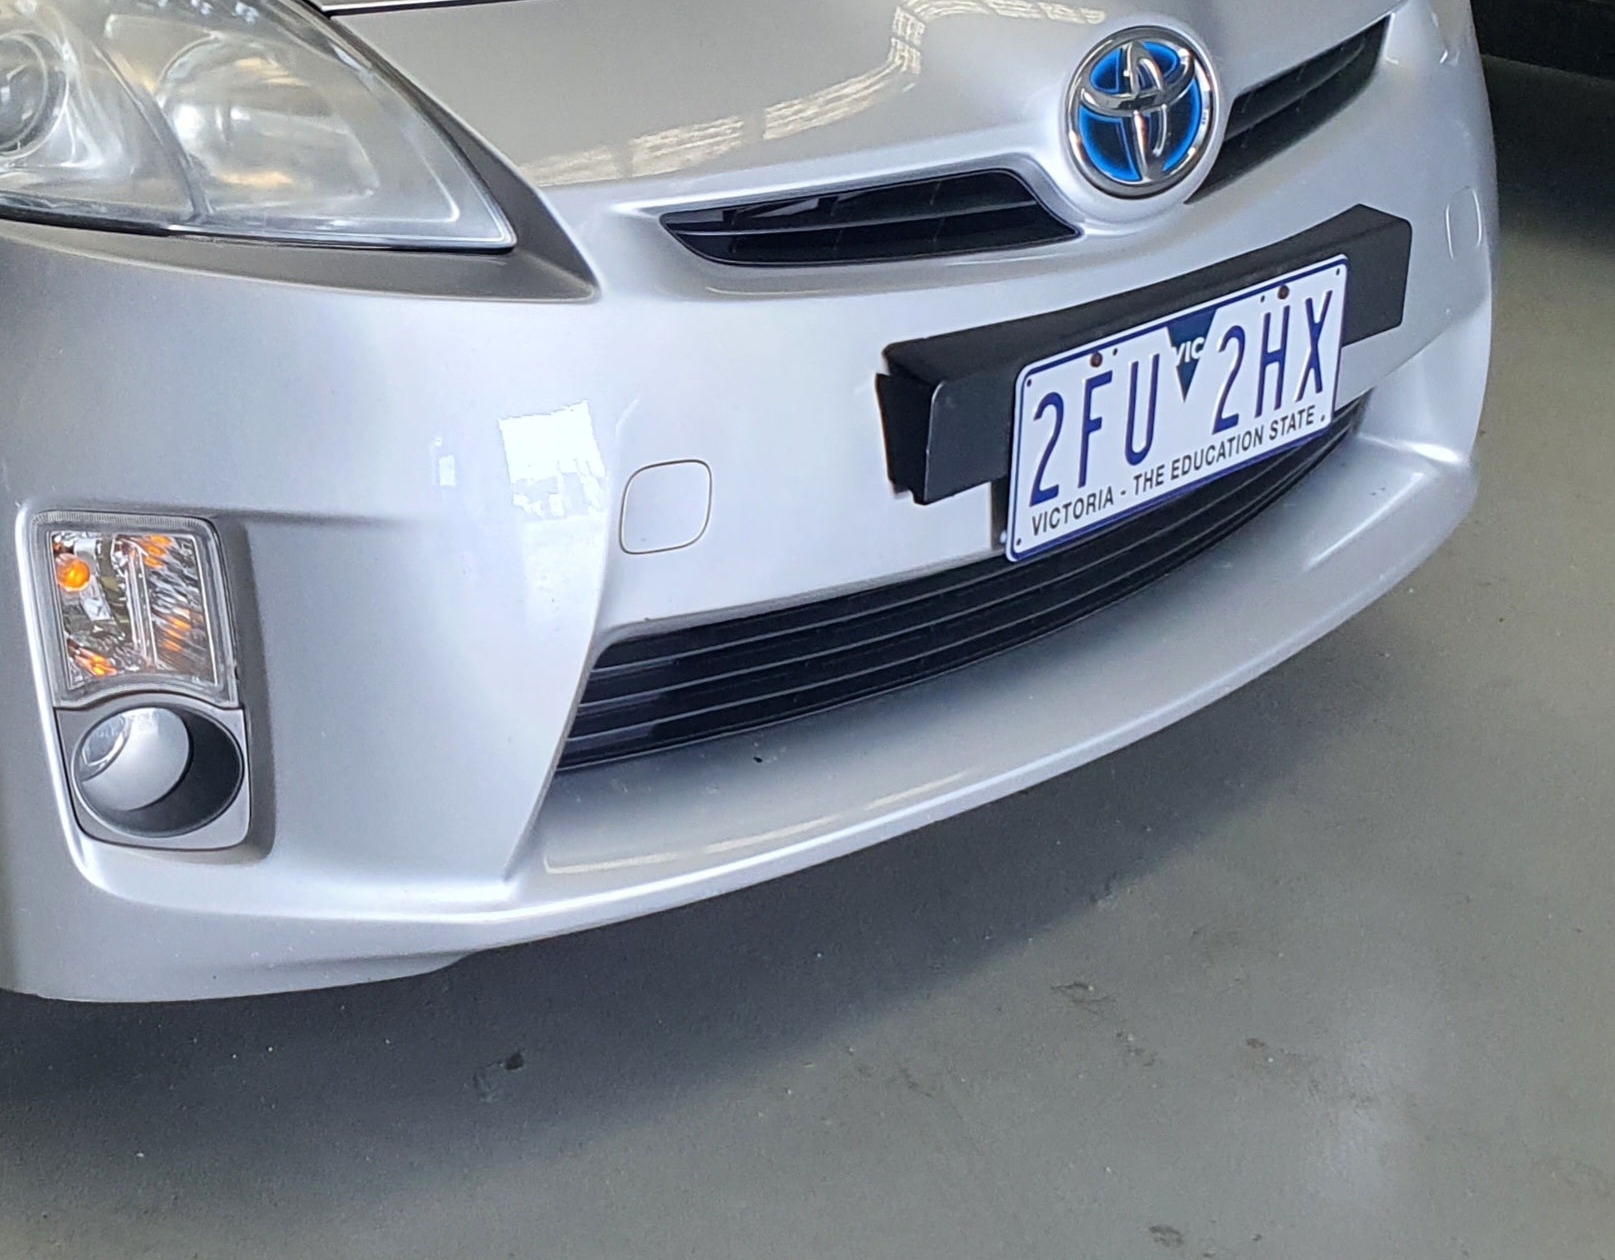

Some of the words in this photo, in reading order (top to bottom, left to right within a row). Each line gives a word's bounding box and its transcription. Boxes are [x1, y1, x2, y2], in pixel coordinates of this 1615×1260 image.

[1029, 352, 1160, 508] 2FU
[1212, 289, 1333, 436] 2HX
[1173, 336, 1207, 367] VIC
[1031, 485, 1115, 536] VICTORIA
[1133, 463, 1165, 496] THE
[1170, 424, 1264, 482] EDUCATION
[1269, 404, 1316, 441] STATE
